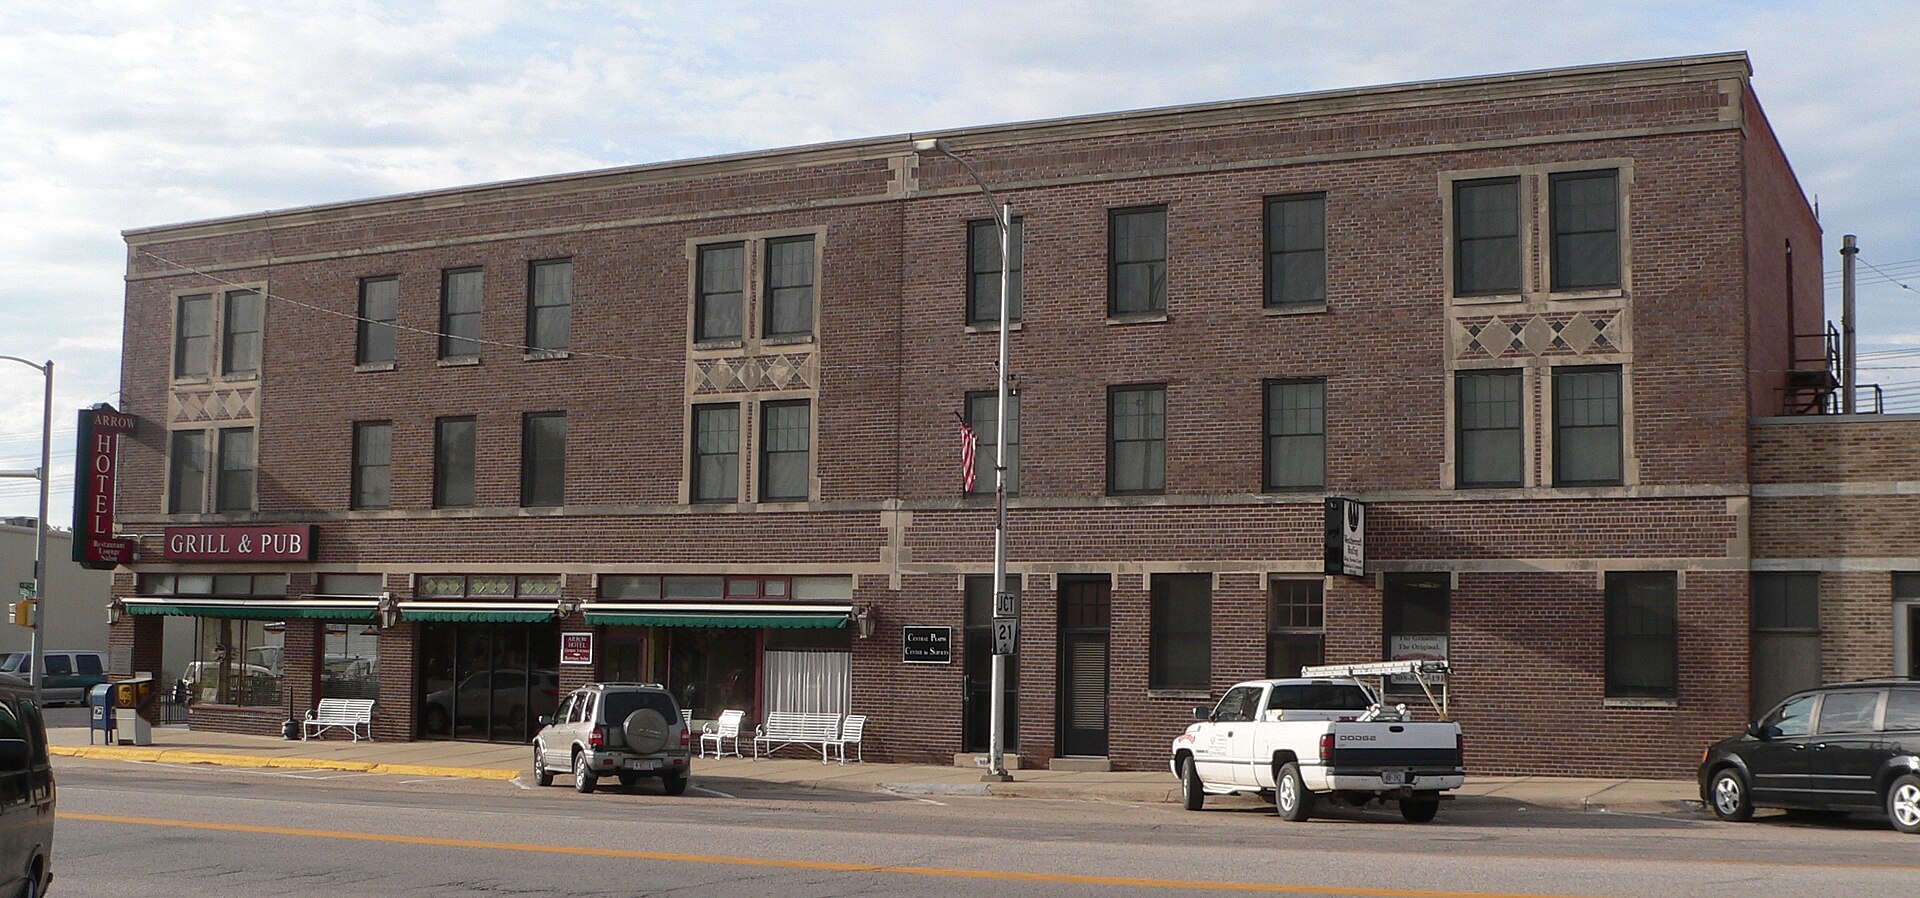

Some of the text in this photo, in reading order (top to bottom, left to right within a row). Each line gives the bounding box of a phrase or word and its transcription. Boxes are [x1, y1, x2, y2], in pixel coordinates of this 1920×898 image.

[94, 414, 136, 429] ARROW
[95, 433, 111, 534] HOTEL
[93, 539, 126, 549] Restaurant
[171, 533, 302, 554] GRILL & PUB
[998, 595, 1014, 612] JCT
[999, 624, 1012, 640] 21
